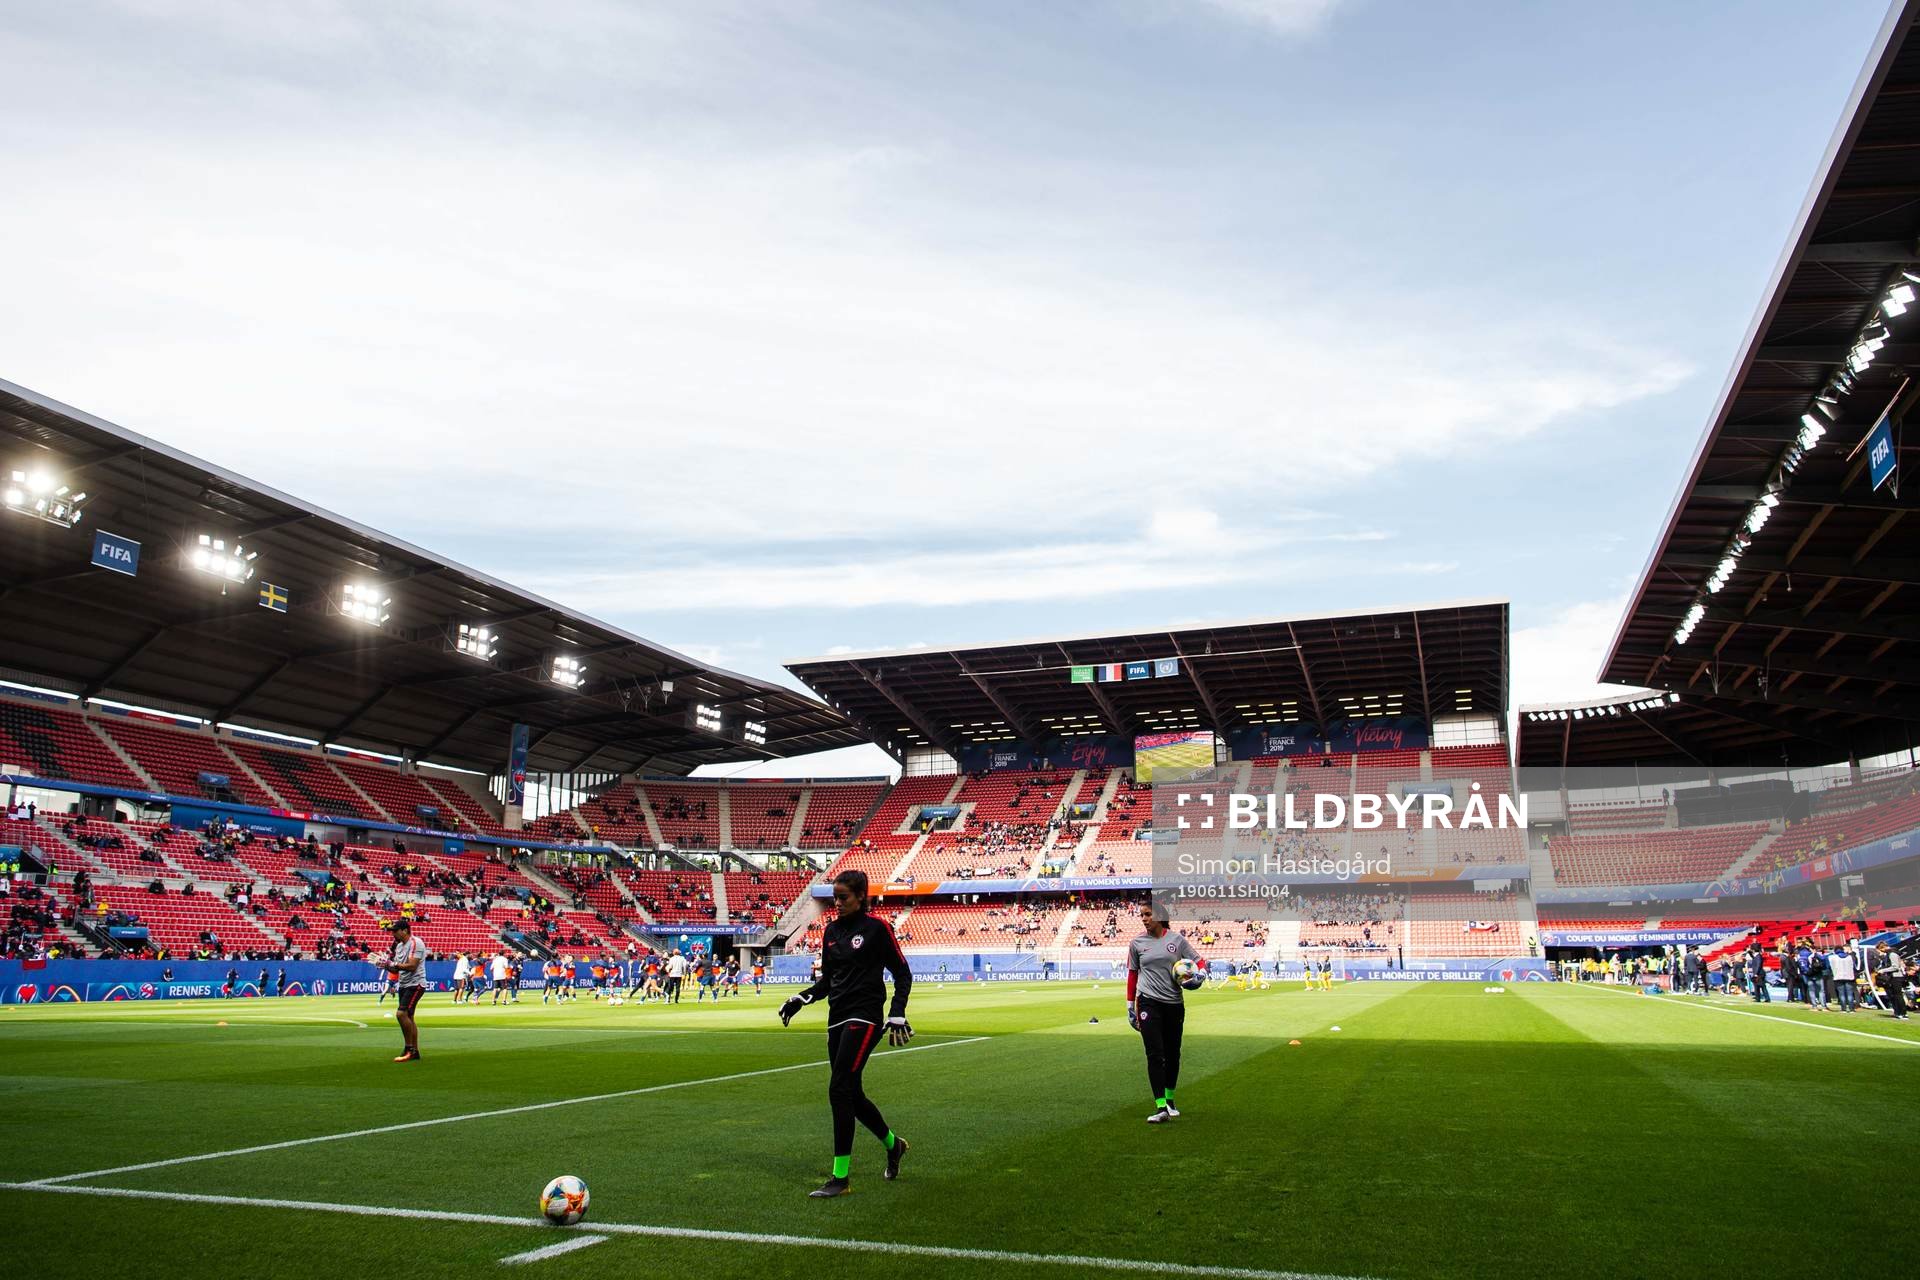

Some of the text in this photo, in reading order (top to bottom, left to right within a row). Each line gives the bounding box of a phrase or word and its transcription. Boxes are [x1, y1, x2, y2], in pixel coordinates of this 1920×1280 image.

[1871, 437, 1890, 470] FIFA
[101, 543, 132, 564] FIFA
[1129, 667, 1146, 675] FIFA
[1353, 725, 1404, 749] Victory
[1071, 742, 1107, 767] Enjoy
[1070, 878, 1085, 886] FIFA
[1121, 877, 1149, 885] WORLD
[1566, 934, 1594, 942] COUPE
[1607, 935, 1638, 943] MONDE
[1688, 932, 1698, 940] LA
[764, 976, 791, 984] COUPE
[792, 975, 806, 983] DU
[912, 973, 943, 982] FRANCE
[943, 973, 961, 982] 2019
[998, 973, 1035, 981] MOMENT
[1368, 971, 1482, 980] LE MOMENT DE BRILLER
[169, 985, 211, 996] RENNES
[337, 982, 348, 993] LE
[350, 982, 385, 992] MOMEN
